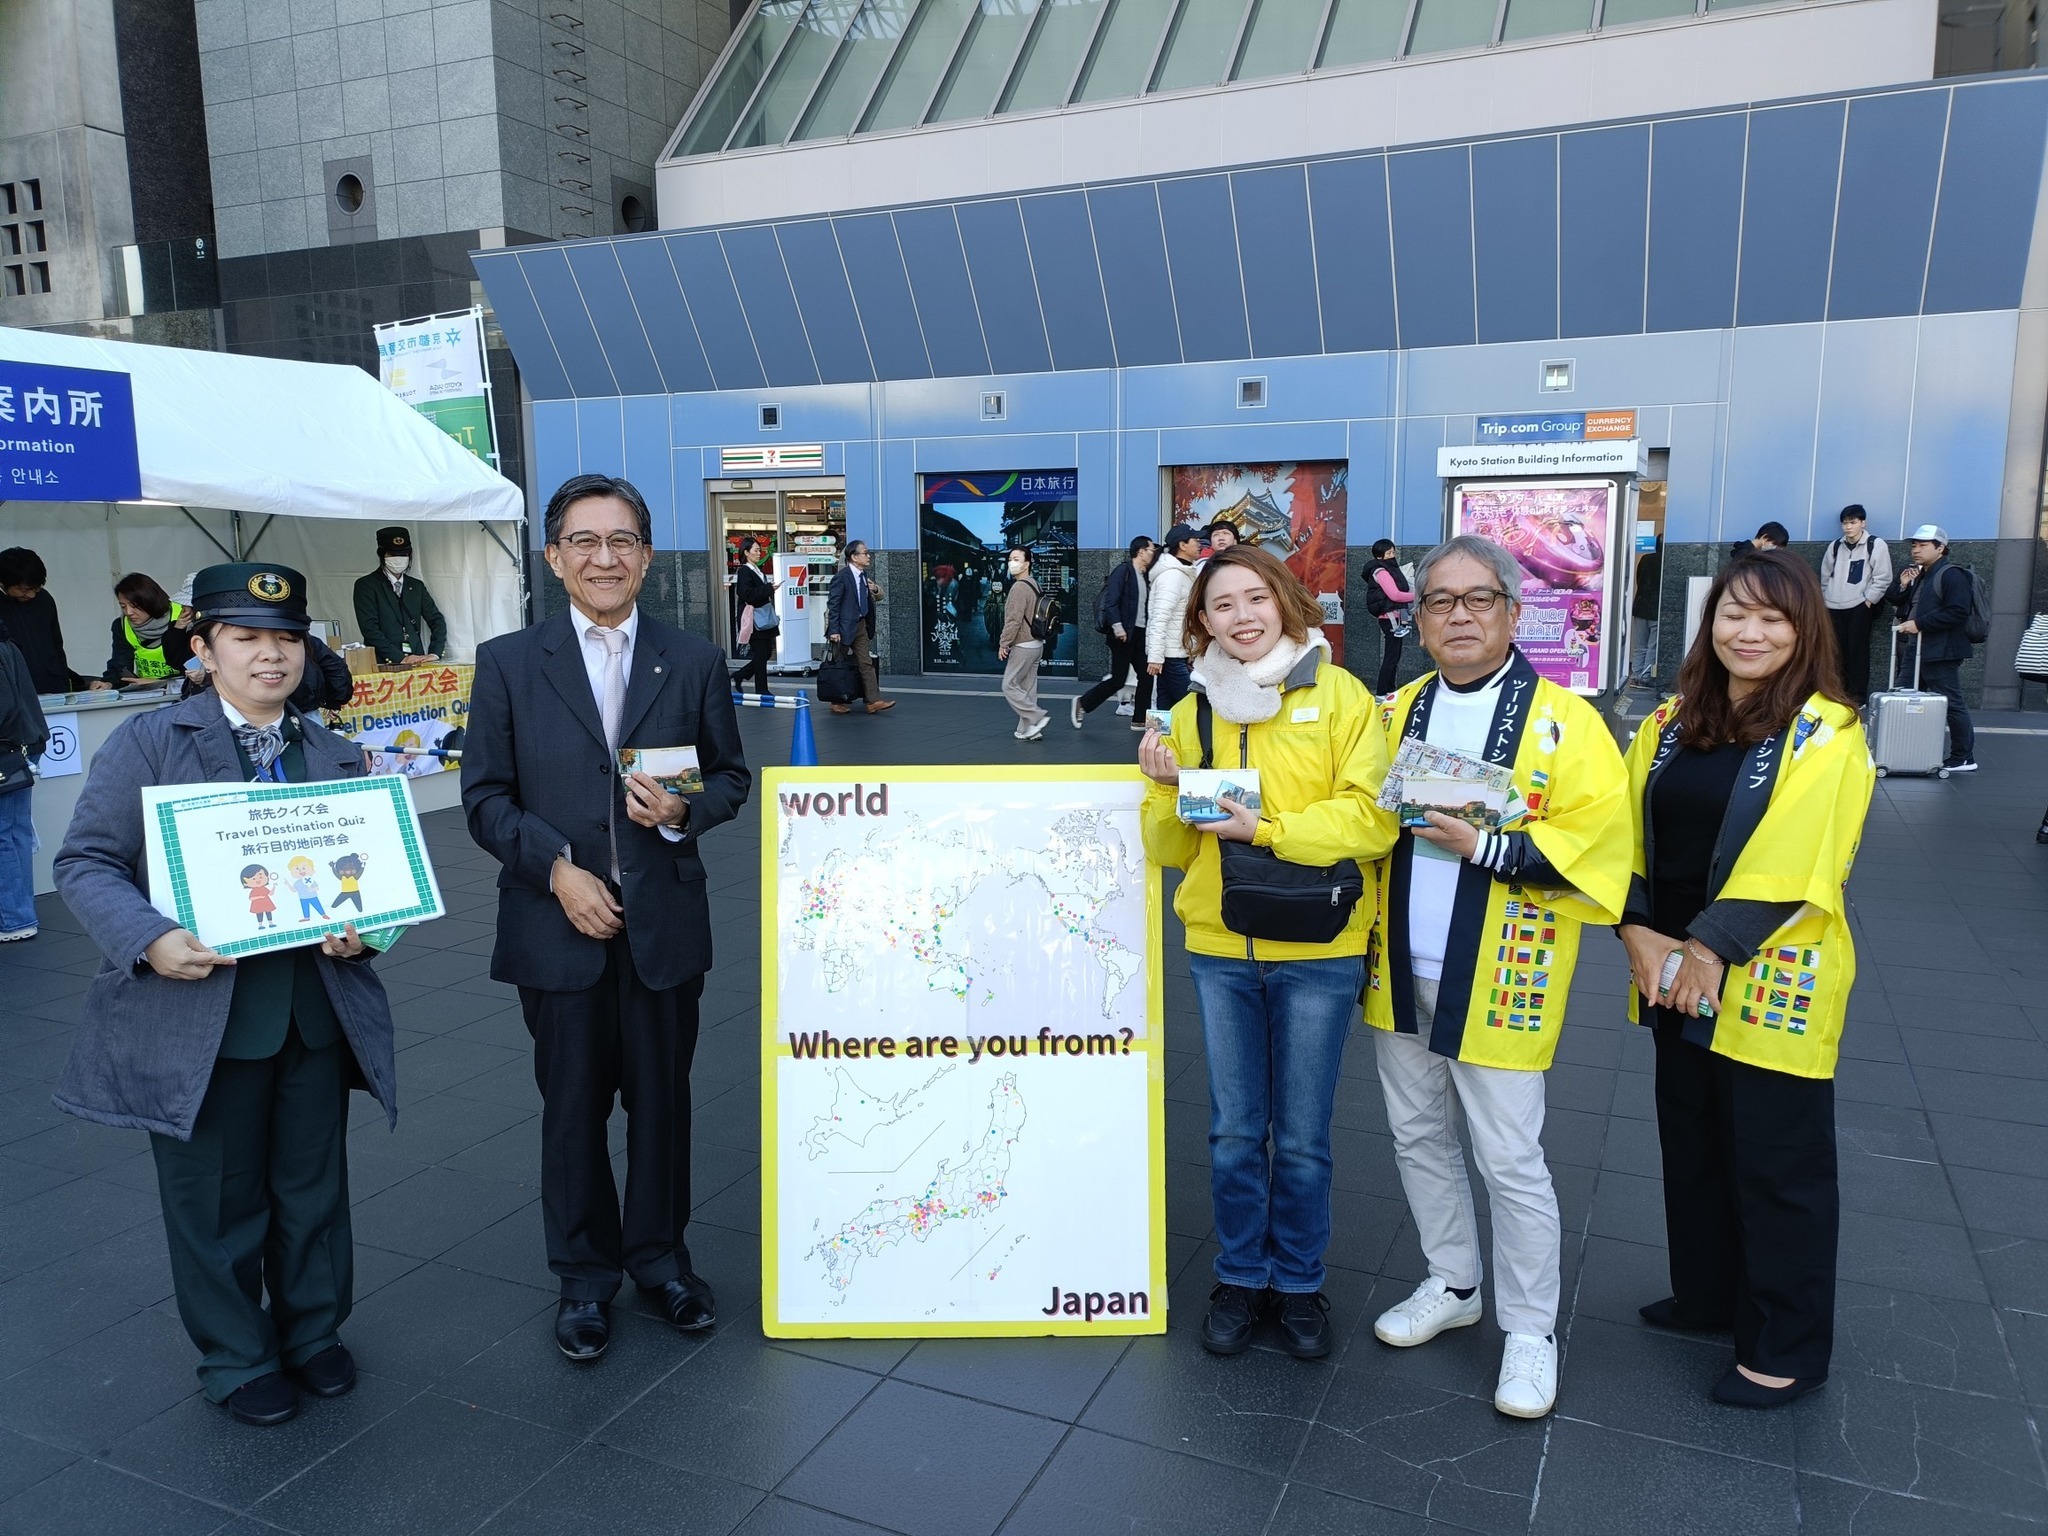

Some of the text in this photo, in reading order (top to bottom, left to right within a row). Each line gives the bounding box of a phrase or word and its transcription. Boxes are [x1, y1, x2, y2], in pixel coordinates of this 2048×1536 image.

[1481, 420, 1581, 437] Trip.com Group
[1587, 416, 1632, 425] CURRENCY
[1587, 424, 1632, 433] EXCHANGE
[1450, 452, 1623, 468] Kyoto Station Building Information
[11, 467, 60, 485] 안내소
[1021, 476, 1075, 490] 日本旅行
[1519, 608, 1566, 621] UTURE
[341, 667, 459, 709] 先クイズ会
[362, 704, 447, 732] Destination
[451, 699, 471, 716] Qu
[1490, 679, 1528, 763] ツーリストシ
[52, 731, 66, 755] 5
[779, 783, 889, 817] world
[248, 803, 330, 822] 旅先クイズ会
[215, 815, 366, 842] Travel Destination Quiz
[242, 833, 350, 856] 旅行目的地问答会
[788, 1027, 1136, 1065] Where are you from?
[1041, 1286, 1149, 1323] Japan
